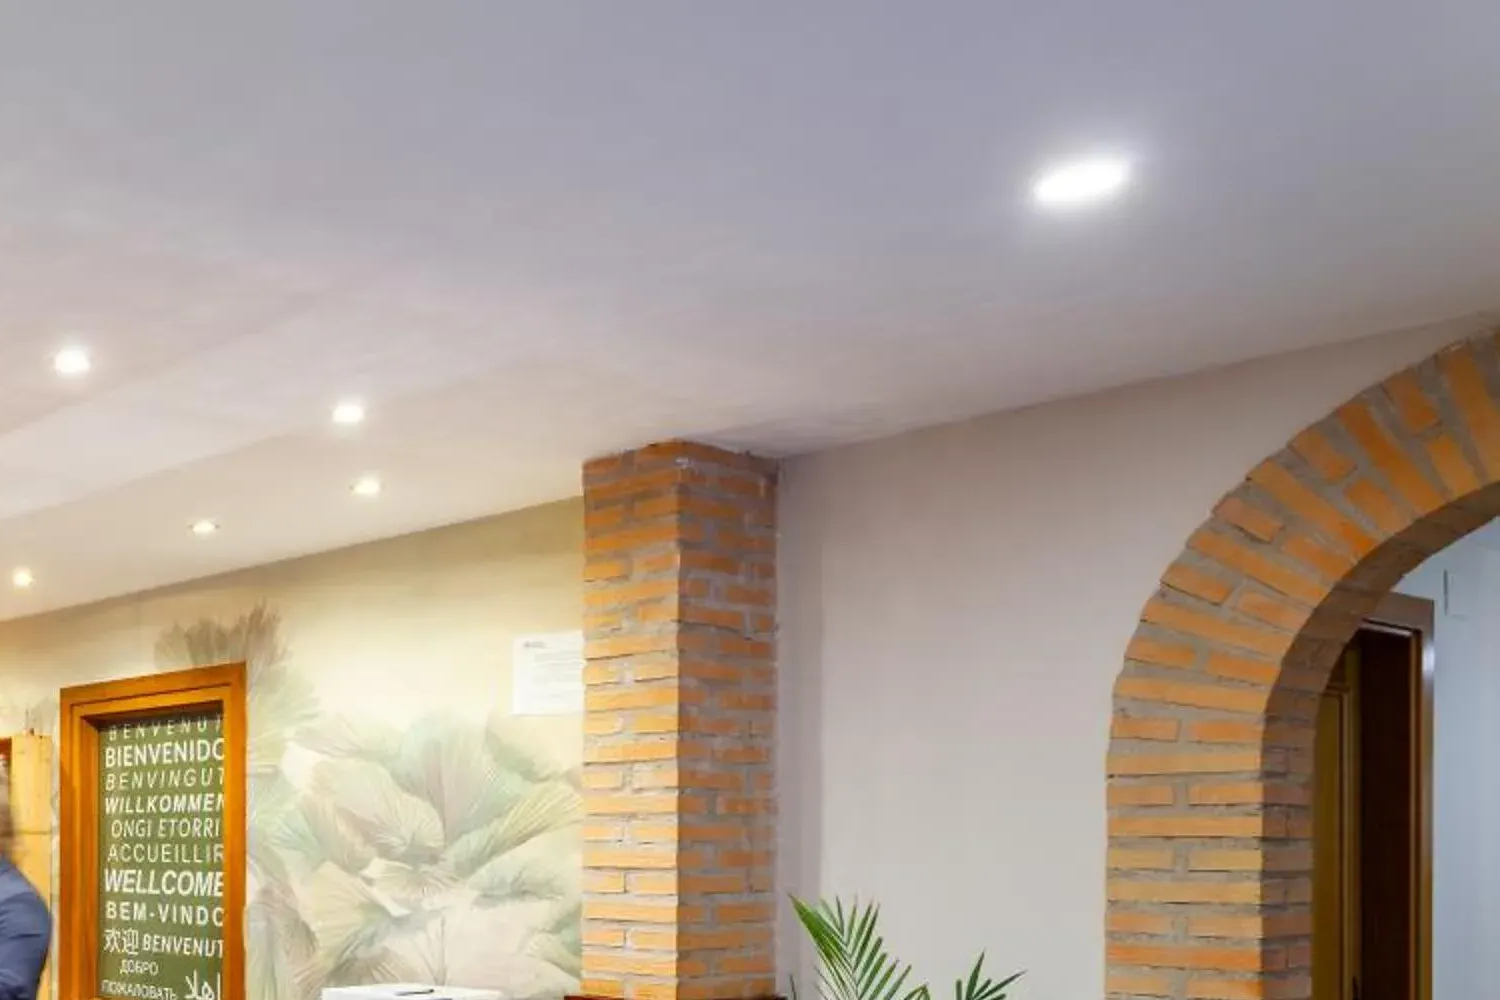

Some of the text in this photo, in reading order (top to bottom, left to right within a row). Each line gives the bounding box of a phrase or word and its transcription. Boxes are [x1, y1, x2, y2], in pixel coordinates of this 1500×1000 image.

[105, 738, 225, 769] BIENVENIDO
[111, 817, 220, 838] ONGI ETORRI
[107, 843, 224, 864] ACCUEILLIR
[104, 868, 224, 897] WELLCOME
[103, 927, 139, 955] 欢迎
[119, 959, 159, 976] ДОБРО
